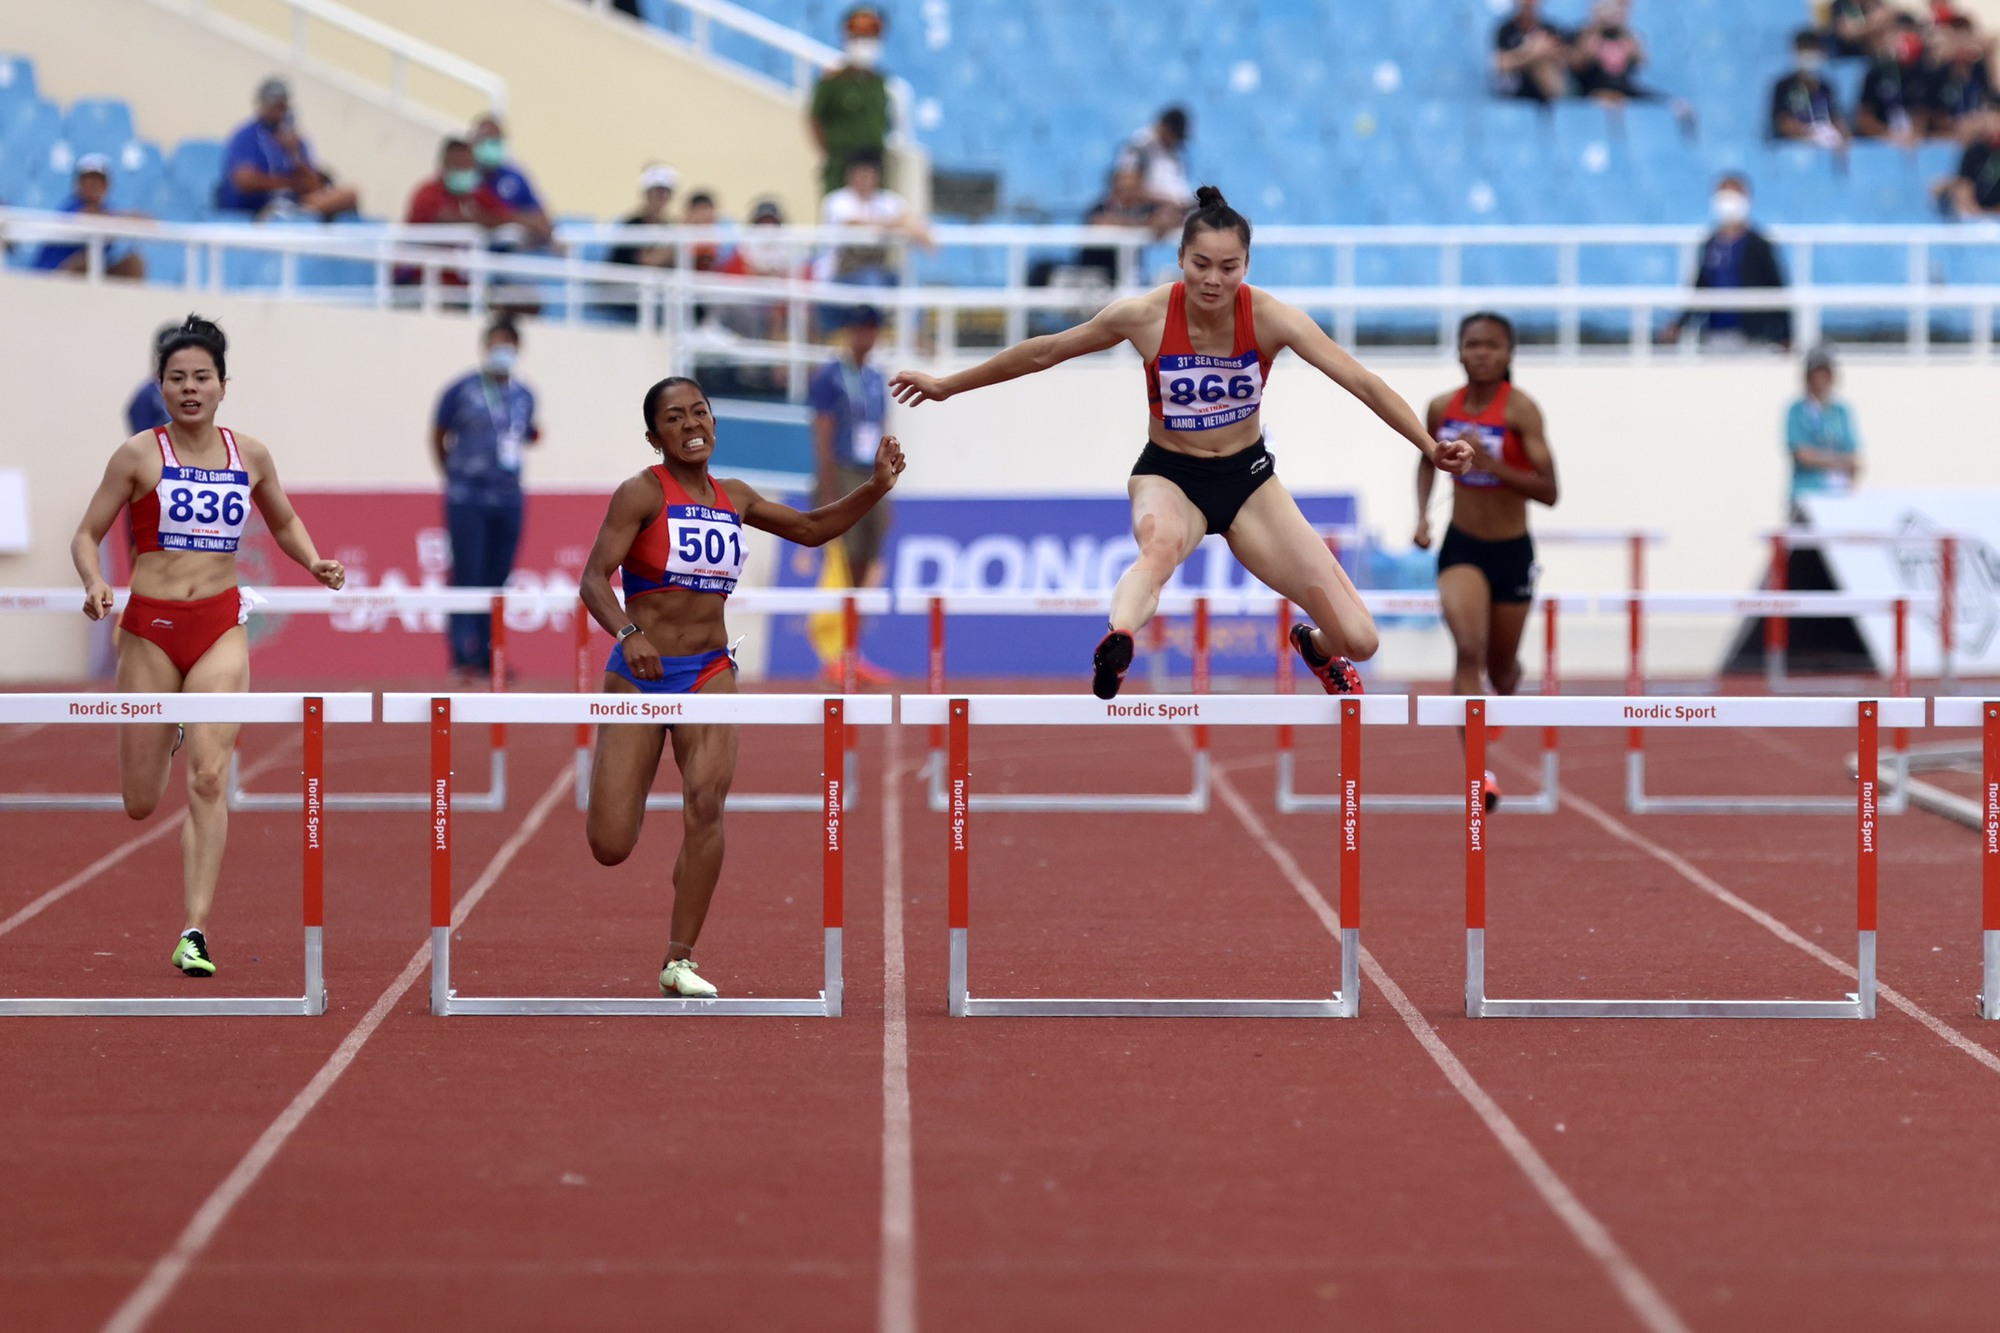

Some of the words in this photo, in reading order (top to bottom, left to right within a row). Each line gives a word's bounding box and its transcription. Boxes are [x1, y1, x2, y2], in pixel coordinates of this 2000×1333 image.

[1195, 356, 1211, 366] SEA
[1213, 360, 1242, 368] Games
[1169, 374, 1254, 406] 866
[1171, 418, 1196, 429] HANOI
[1203, 411, 1236, 427] VIETNAM
[1198, 404, 1229, 413] VIETNAM
[194, 470, 208, 482] SEA
[209, 471, 235, 482] Games
[168, 487, 244, 527] 836
[701, 507, 712, 519] SEA
[712, 510, 733, 522] Games
[163, 535, 187, 547] HANOI
[193, 539, 224, 550] VIETNAM
[678, 526, 740, 567] 501
[699, 578, 724, 589] VIETNAM
[121, 703, 162, 718] Sport
[642, 703, 683, 719] Sport
[1159, 704, 1200, 719] Sport
[1675, 706, 1716, 721] Sport
[306, 817, 319, 849] Sport
[434, 818, 446, 850] Sport
[826, 820, 839, 851] Sport
[952, 819, 964, 851] Sport
[1344, 819, 1356, 851] Sport
[1469, 819, 1481, 851] Sport
[1861, 821, 1874, 853] Sport
[1986, 822, 1999, 853] Sport
